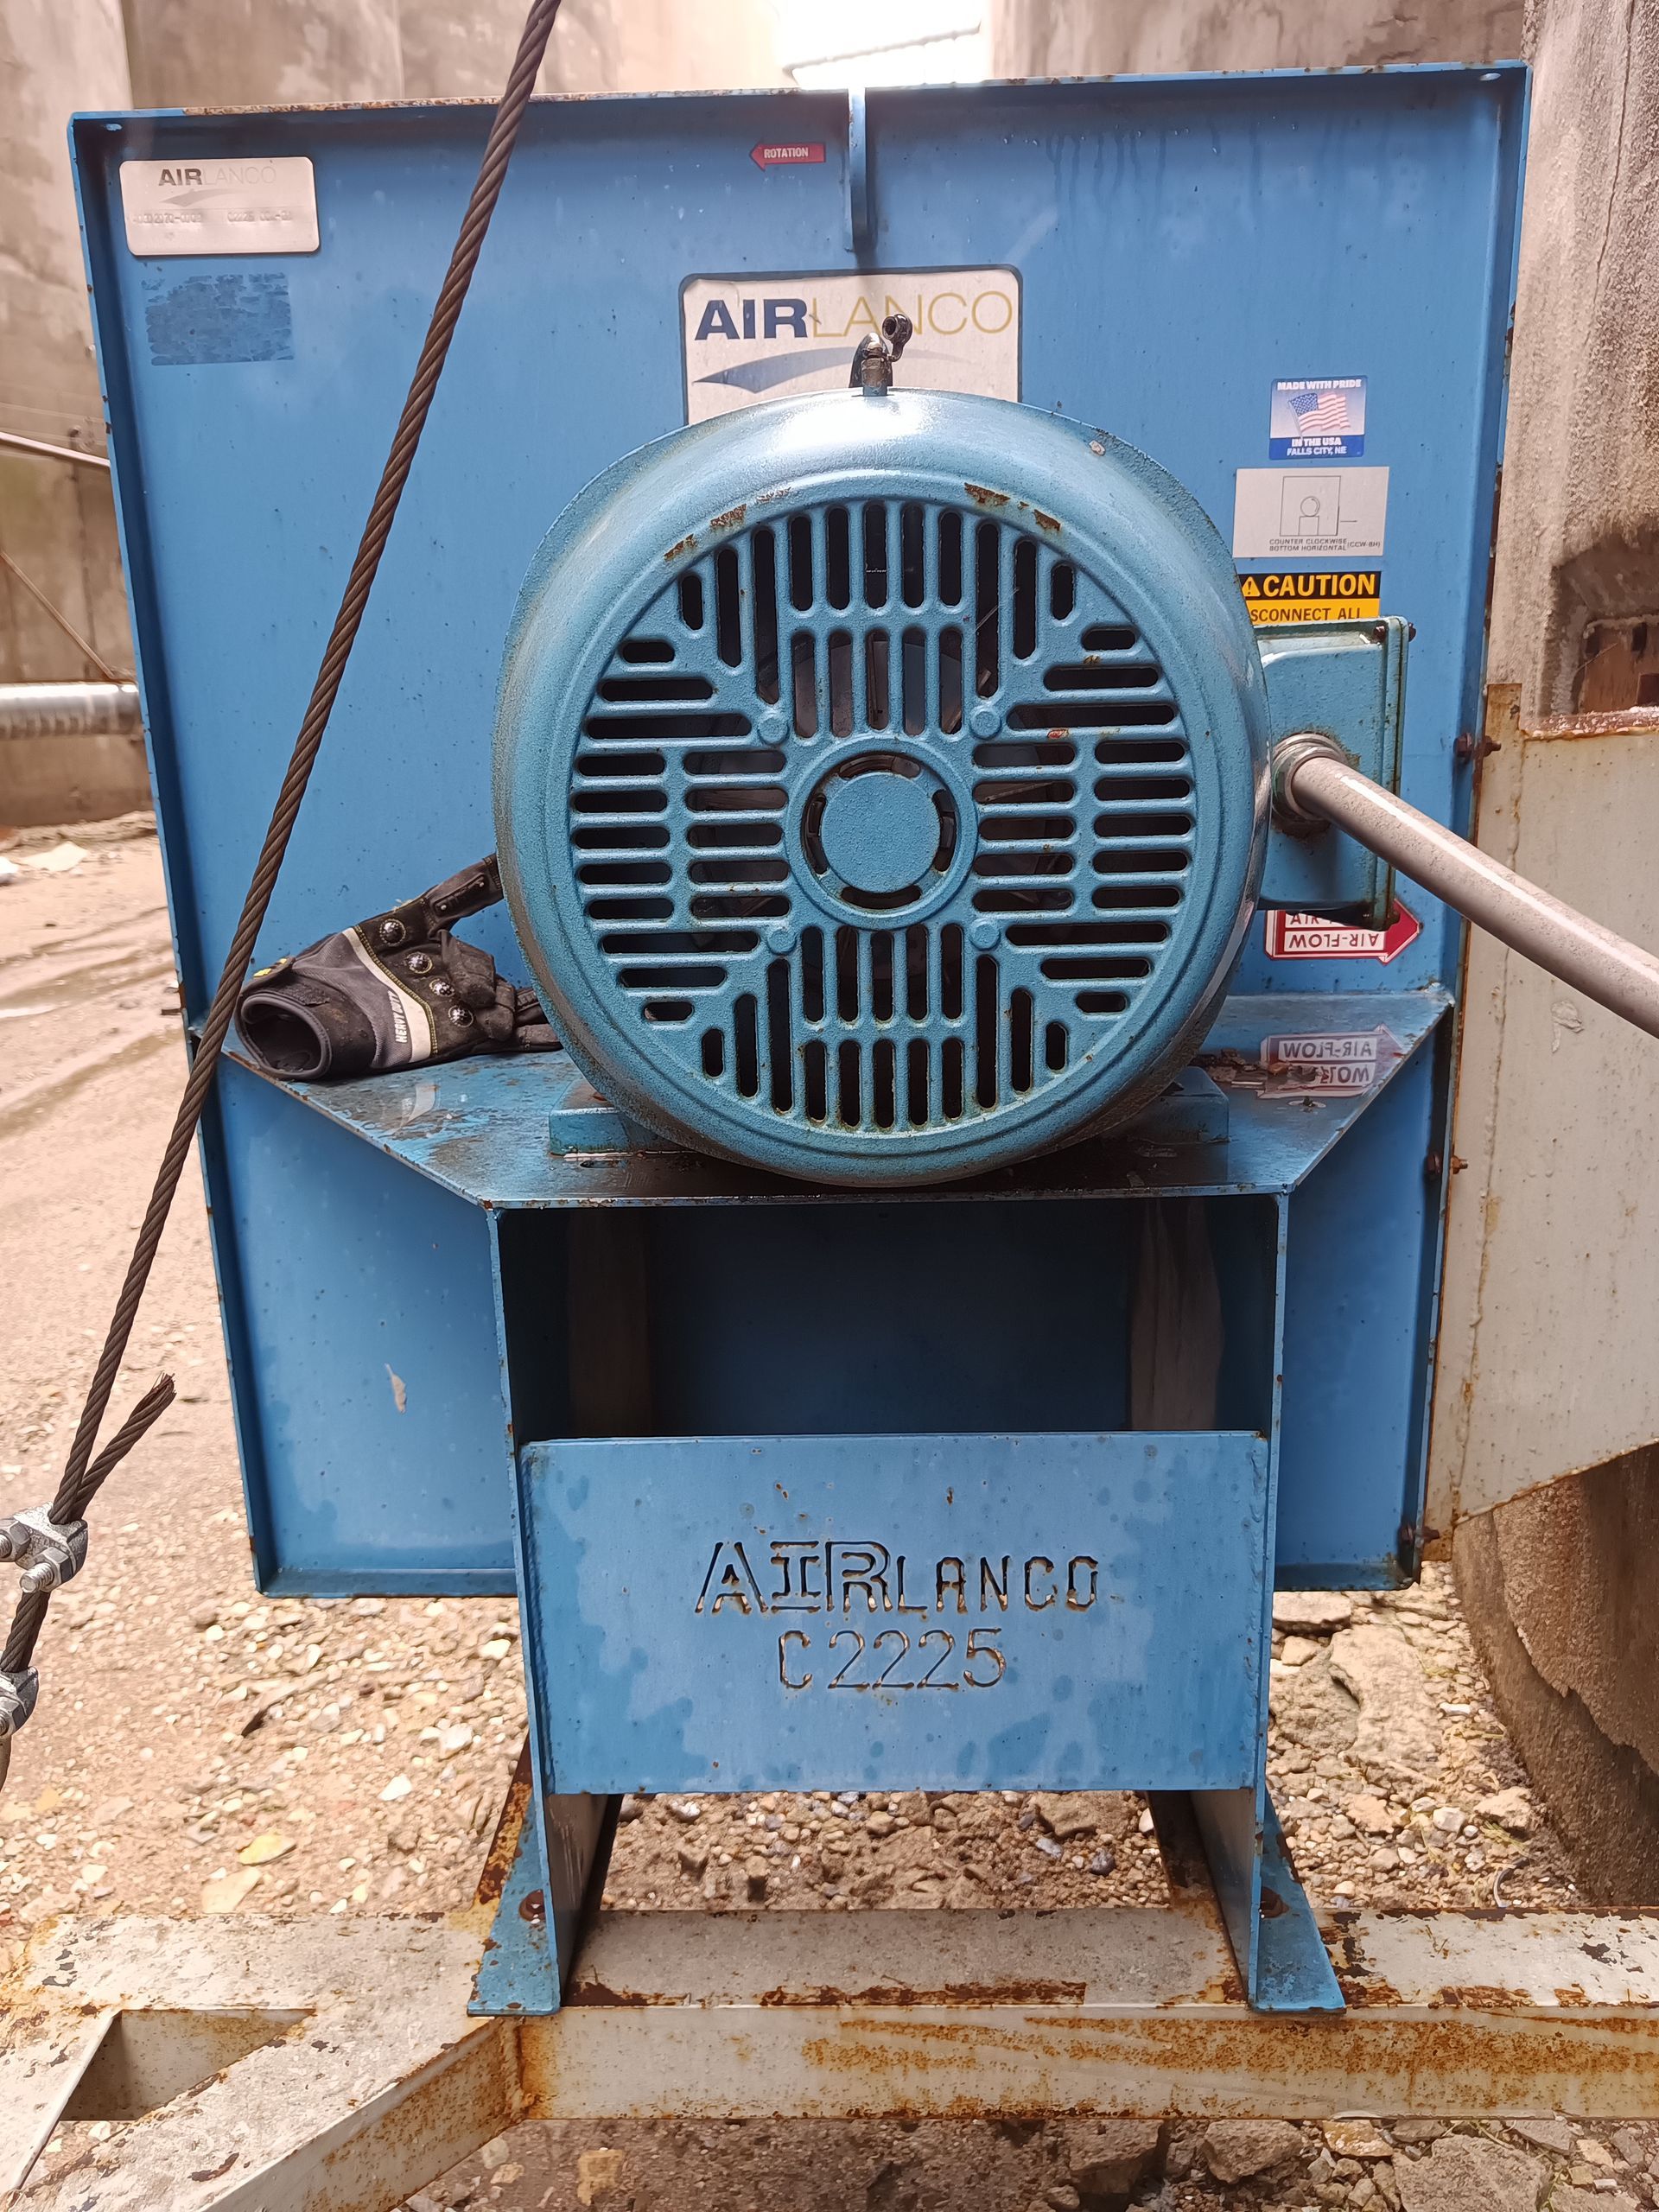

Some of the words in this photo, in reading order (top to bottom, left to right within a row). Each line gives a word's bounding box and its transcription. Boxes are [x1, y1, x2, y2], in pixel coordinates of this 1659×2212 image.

[763, 146, 809, 159] ROTATION
[1277, 381, 1305, 391] MADE
[1306, 380, 1332, 390] WITH
[1332, 378, 1362, 389] PRIDE
[1291, 438, 1303, 447] IN
[1304, 437, 1321, 447] THE
[1322, 436, 1342, 446] USA
[1287, 448, 1313, 456] FALLS
[1334, 446, 1347, 454] NE
[1262, 574, 1376, 597] CAUTION
[1250, 607, 1332, 622] SCONNECT
[1288, 933, 1379, 949] AIR-FLOW
[694, 1540, 1099, 1614] AIRLANCO
